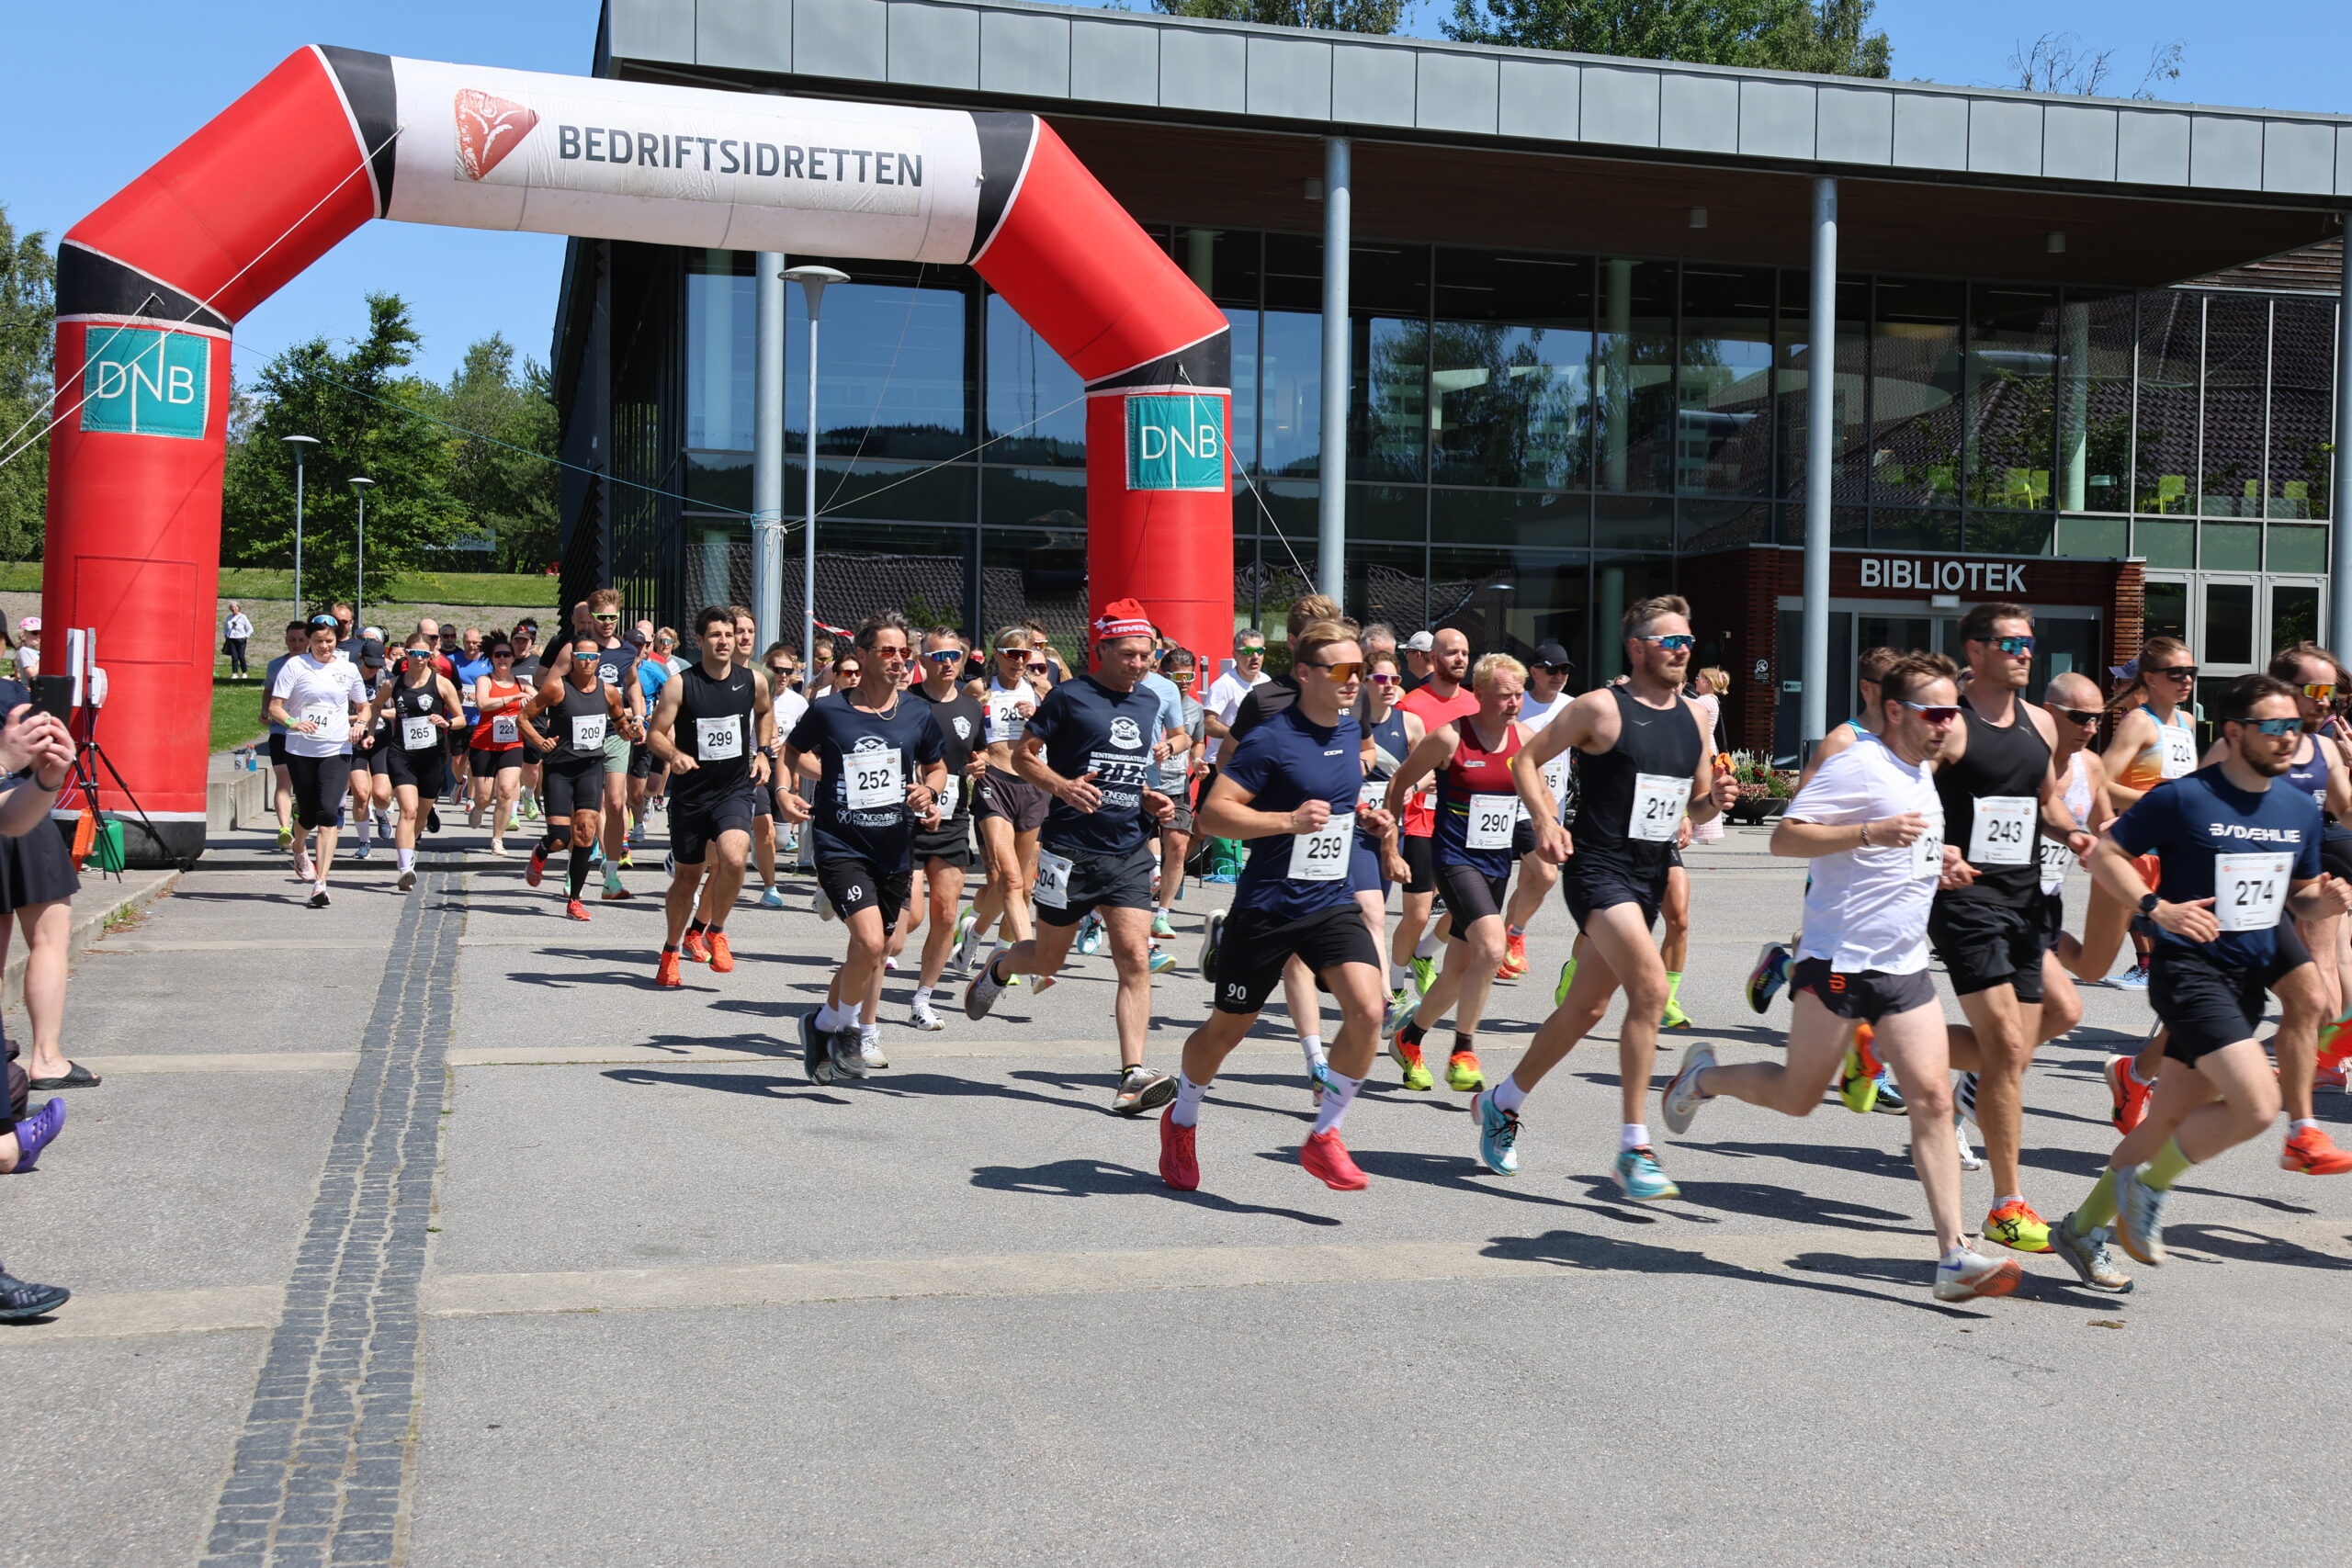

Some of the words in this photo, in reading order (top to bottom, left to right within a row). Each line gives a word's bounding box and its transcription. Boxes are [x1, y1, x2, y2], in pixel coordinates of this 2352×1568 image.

[559, 124, 922, 187] BEDRIFTSIDRETTEN
[1860, 558, 2027, 592] BIBLIOTEK
[410, 727, 429, 739] 265
[499, 724, 514, 735] 223
[581, 727, 600, 739] 209
[707, 731, 732, 747] 299
[857, 769, 890, 791] 252
[1646, 797, 1677, 820] 214
[1480, 814, 1509, 832] 290
[1987, 819, 2022, 843] 243
[1307, 836, 1342, 859] 259
[2039, 844, 2068, 865] 272
[1040, 868, 1056, 890] 04
[847, 885, 863, 902] 49
[2235, 880, 2275, 907] 274
[1227, 983, 1247, 1000] 90
